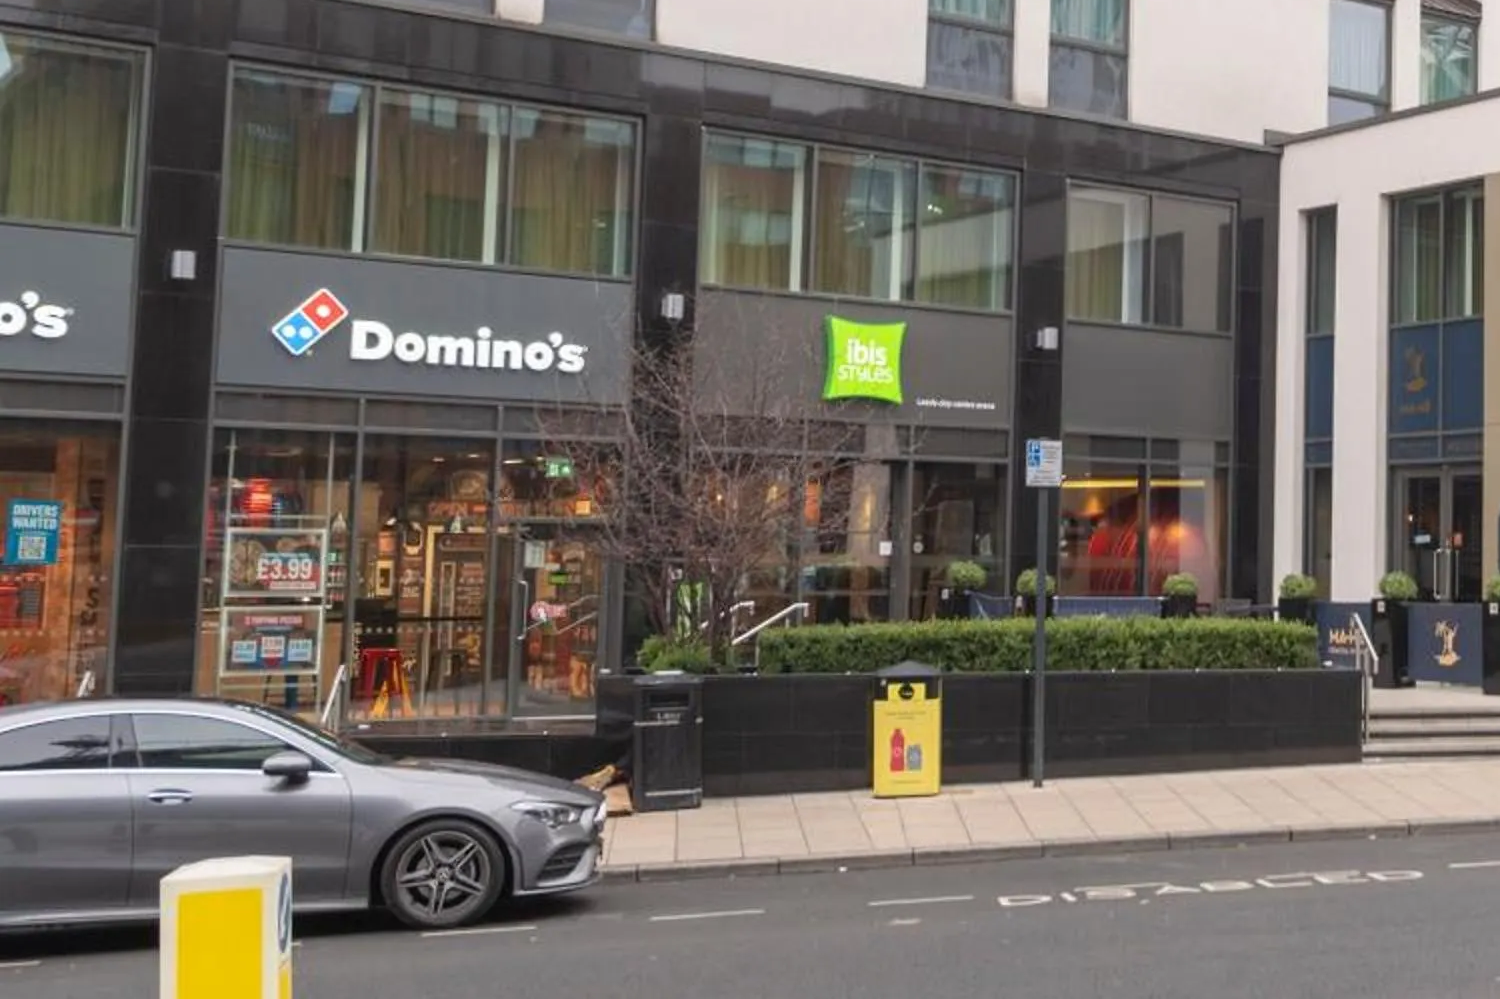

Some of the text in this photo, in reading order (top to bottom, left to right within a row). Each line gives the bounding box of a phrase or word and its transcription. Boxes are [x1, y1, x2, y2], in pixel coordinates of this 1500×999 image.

[350, 319, 586, 373] Domino's
[847, 337, 888, 366] ibis
[12, 504, 59, 517] DRIVERS
[11, 517, 58, 530] WANTED
[256, 557, 313, 580] £3.99
